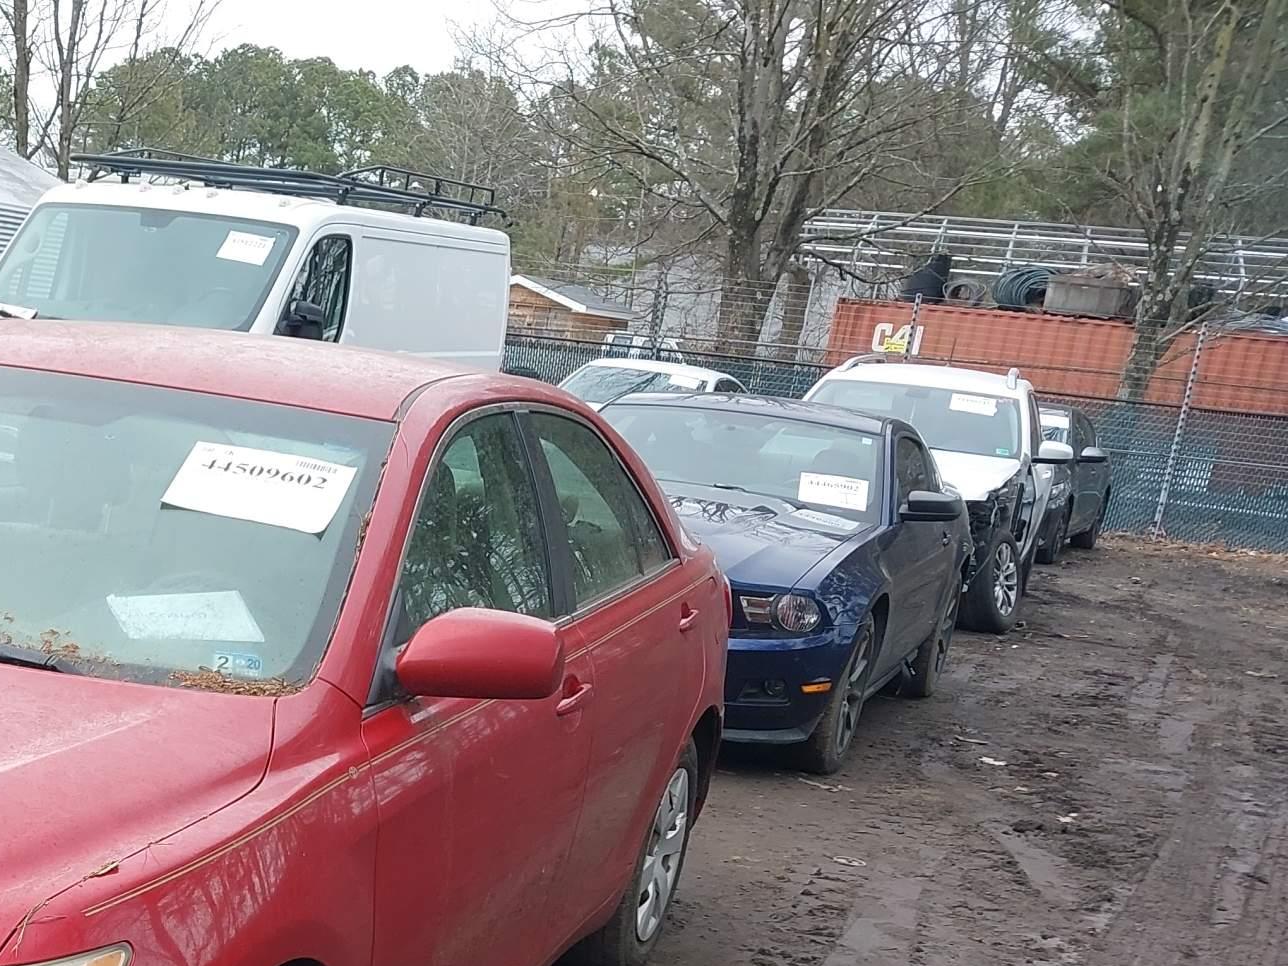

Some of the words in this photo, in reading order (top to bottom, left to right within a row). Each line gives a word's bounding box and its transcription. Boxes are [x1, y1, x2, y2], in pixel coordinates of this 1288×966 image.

[201, 458, 328, 489] 44509602
[217, 655, 229, 670] 2
[247, 658, 261, 670] 20
